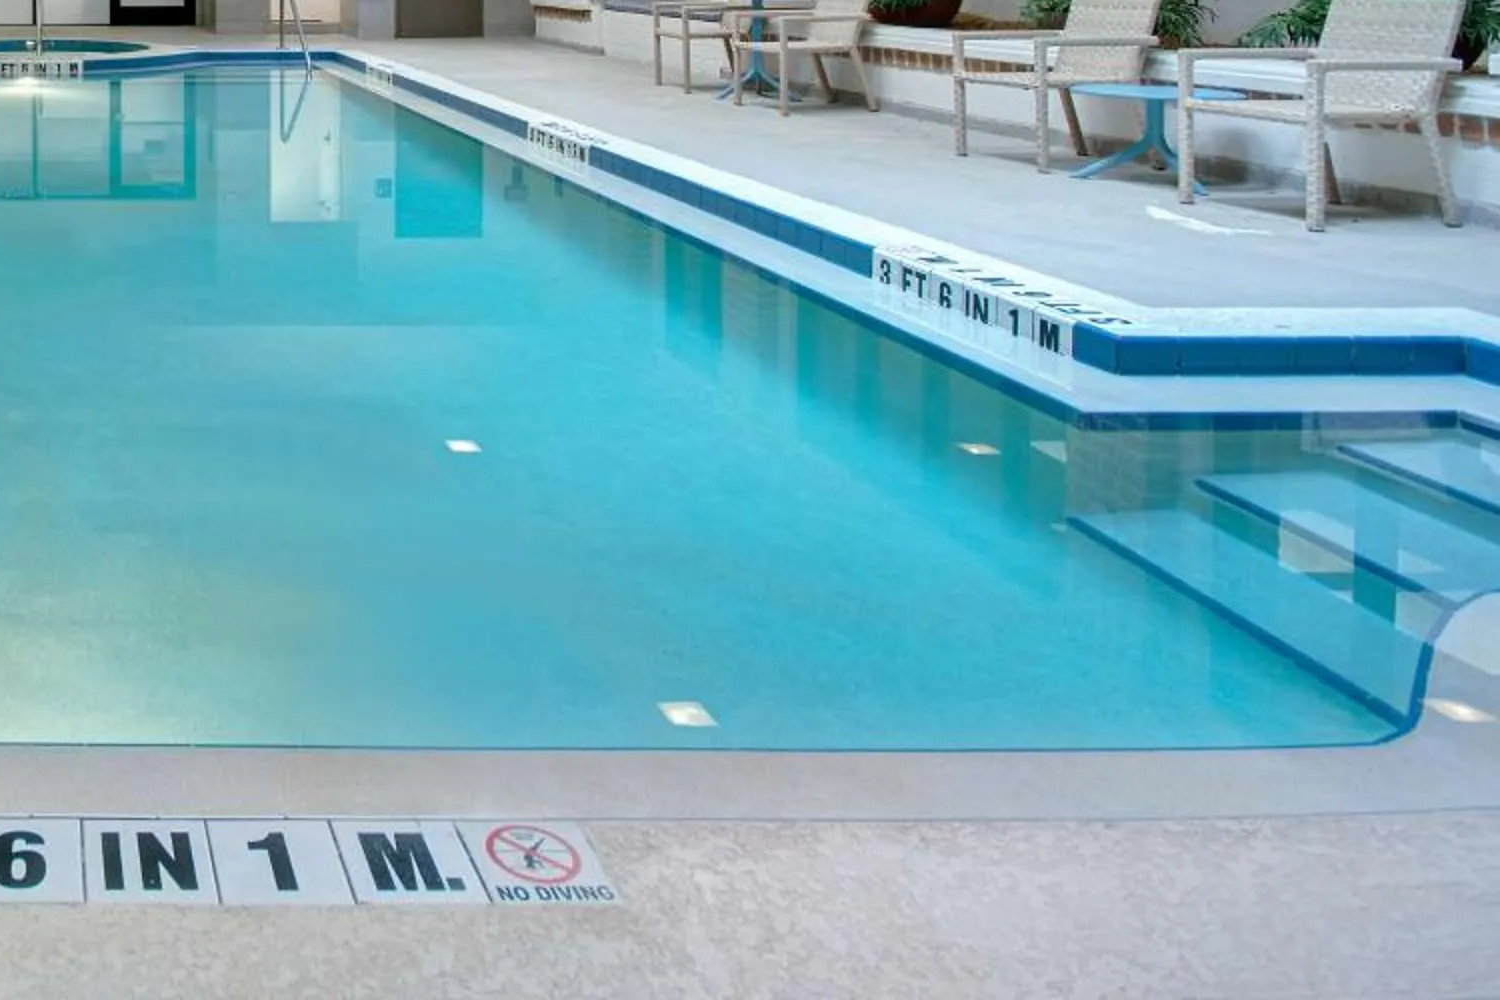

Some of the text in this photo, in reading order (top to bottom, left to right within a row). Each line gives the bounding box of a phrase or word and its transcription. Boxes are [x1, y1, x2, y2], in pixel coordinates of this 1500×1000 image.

[880, 259, 891, 285] 3
[901, 268, 927, 299] FT
[939, 281, 952, 309] 6
[965, 290, 989, 325] IN
[1008, 308, 1019, 337] 1
[100, 831, 200, 891] IN
[247, 832, 299, 892] 1
[357, 832, 466, 892] M.
[496, 884, 616, 902] NO DIVING
